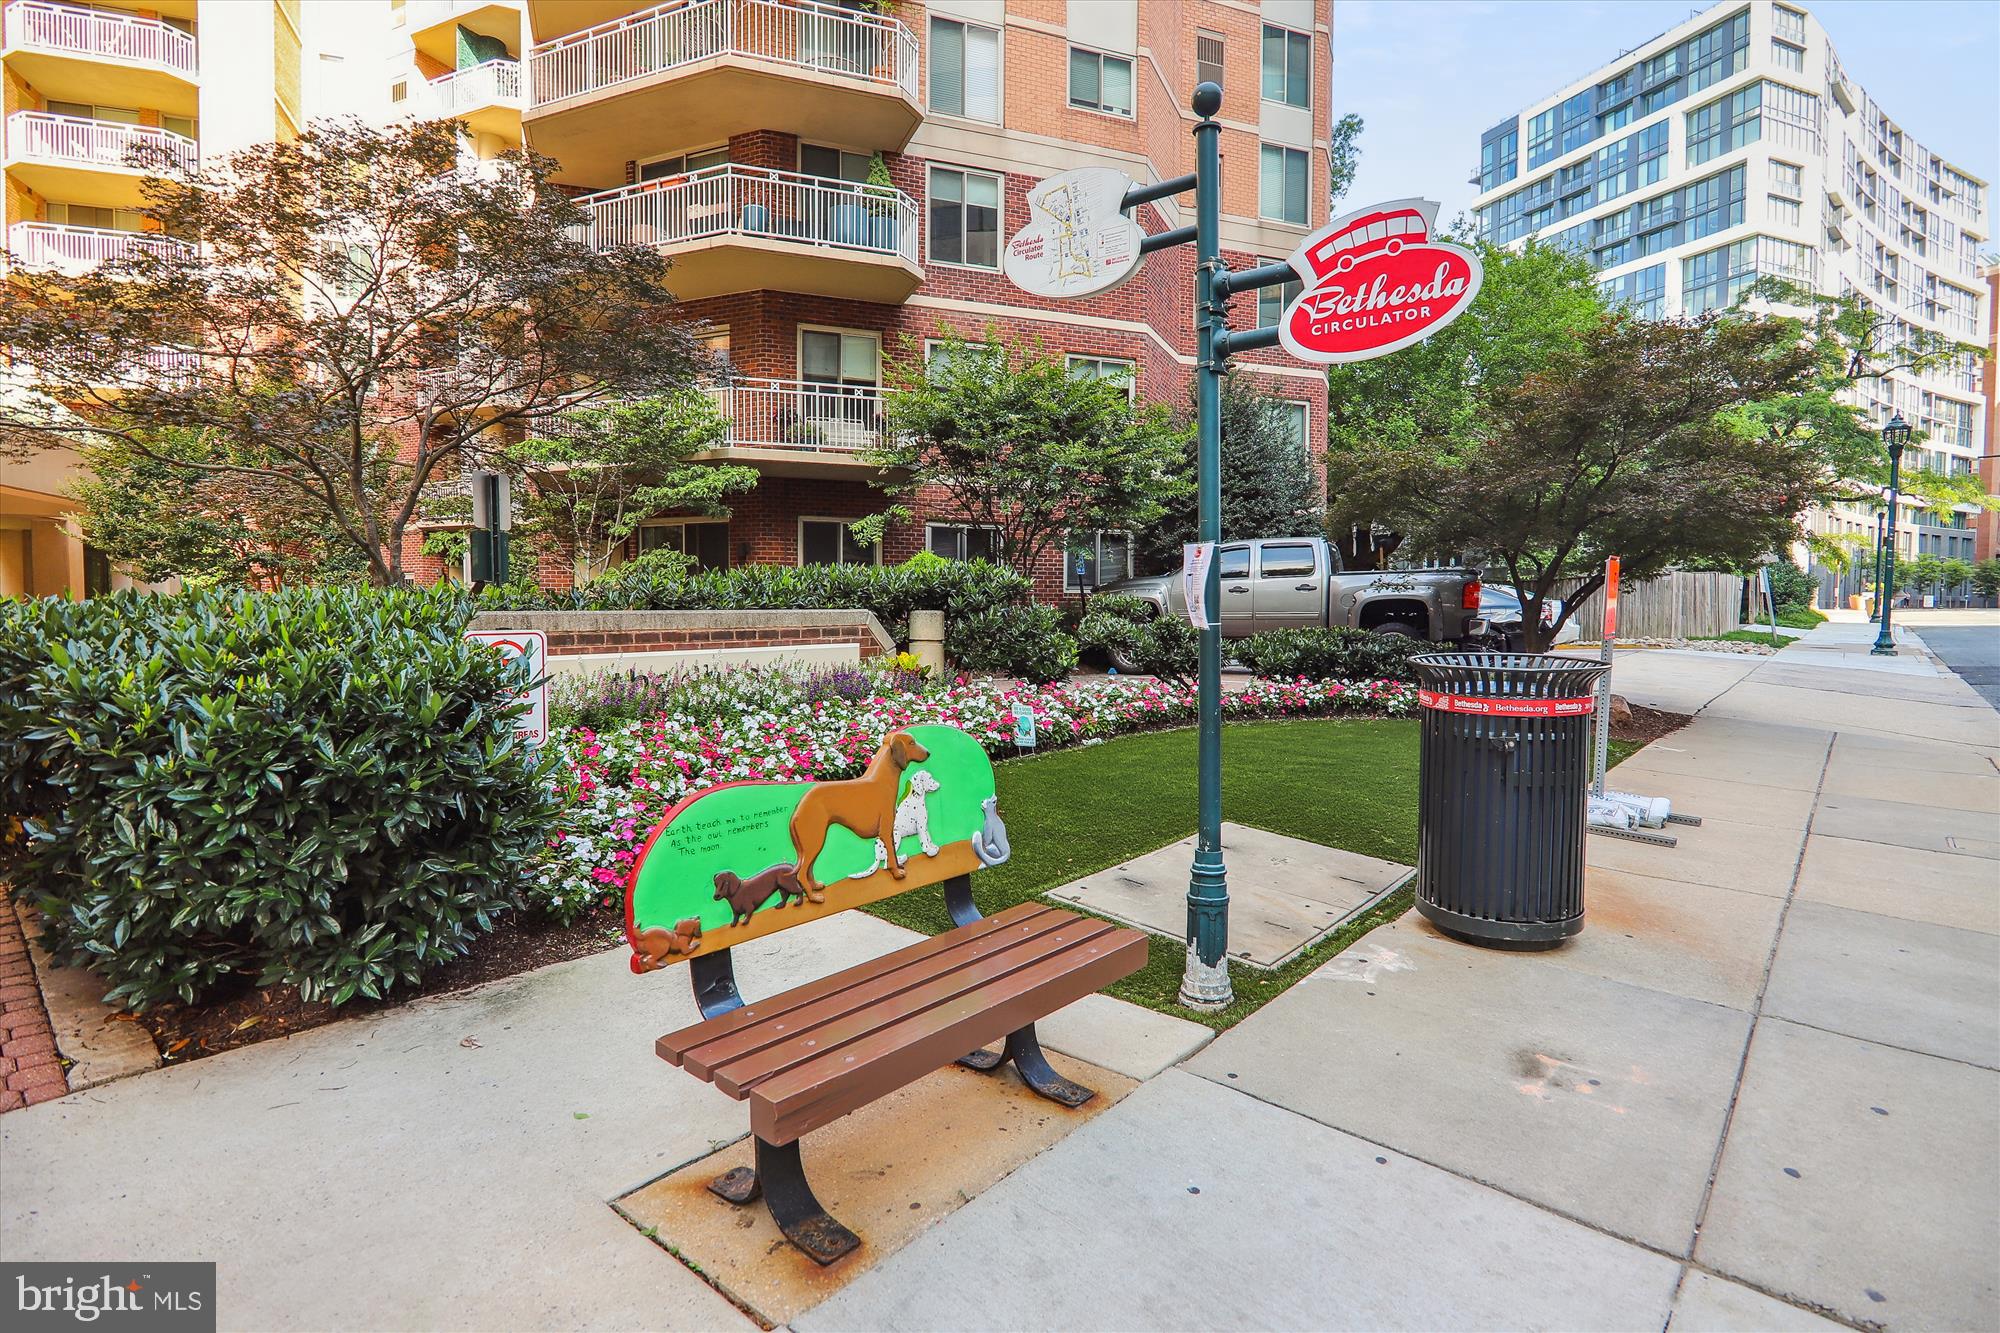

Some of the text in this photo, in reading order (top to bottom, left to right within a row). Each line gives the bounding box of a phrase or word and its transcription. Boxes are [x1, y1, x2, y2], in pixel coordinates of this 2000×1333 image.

[1012, 234, 1044, 249] Bethesda
[1013, 244, 1044, 257] Circulator
[1024, 252, 1044, 261] Route
[1298, 261, 1471, 324] Bethesda
[1311, 305, 1432, 336] CIRCULATOR
[1454, 699, 1482, 708] Bethesda
[1495, 703, 1548, 714] Bethesda.org
[665, 825, 692, 837] Earth
[696, 819, 720, 831] teach
[671, 839, 681, 847] As
[686, 835, 701, 843] the
[678, 843, 720, 856] The moon
